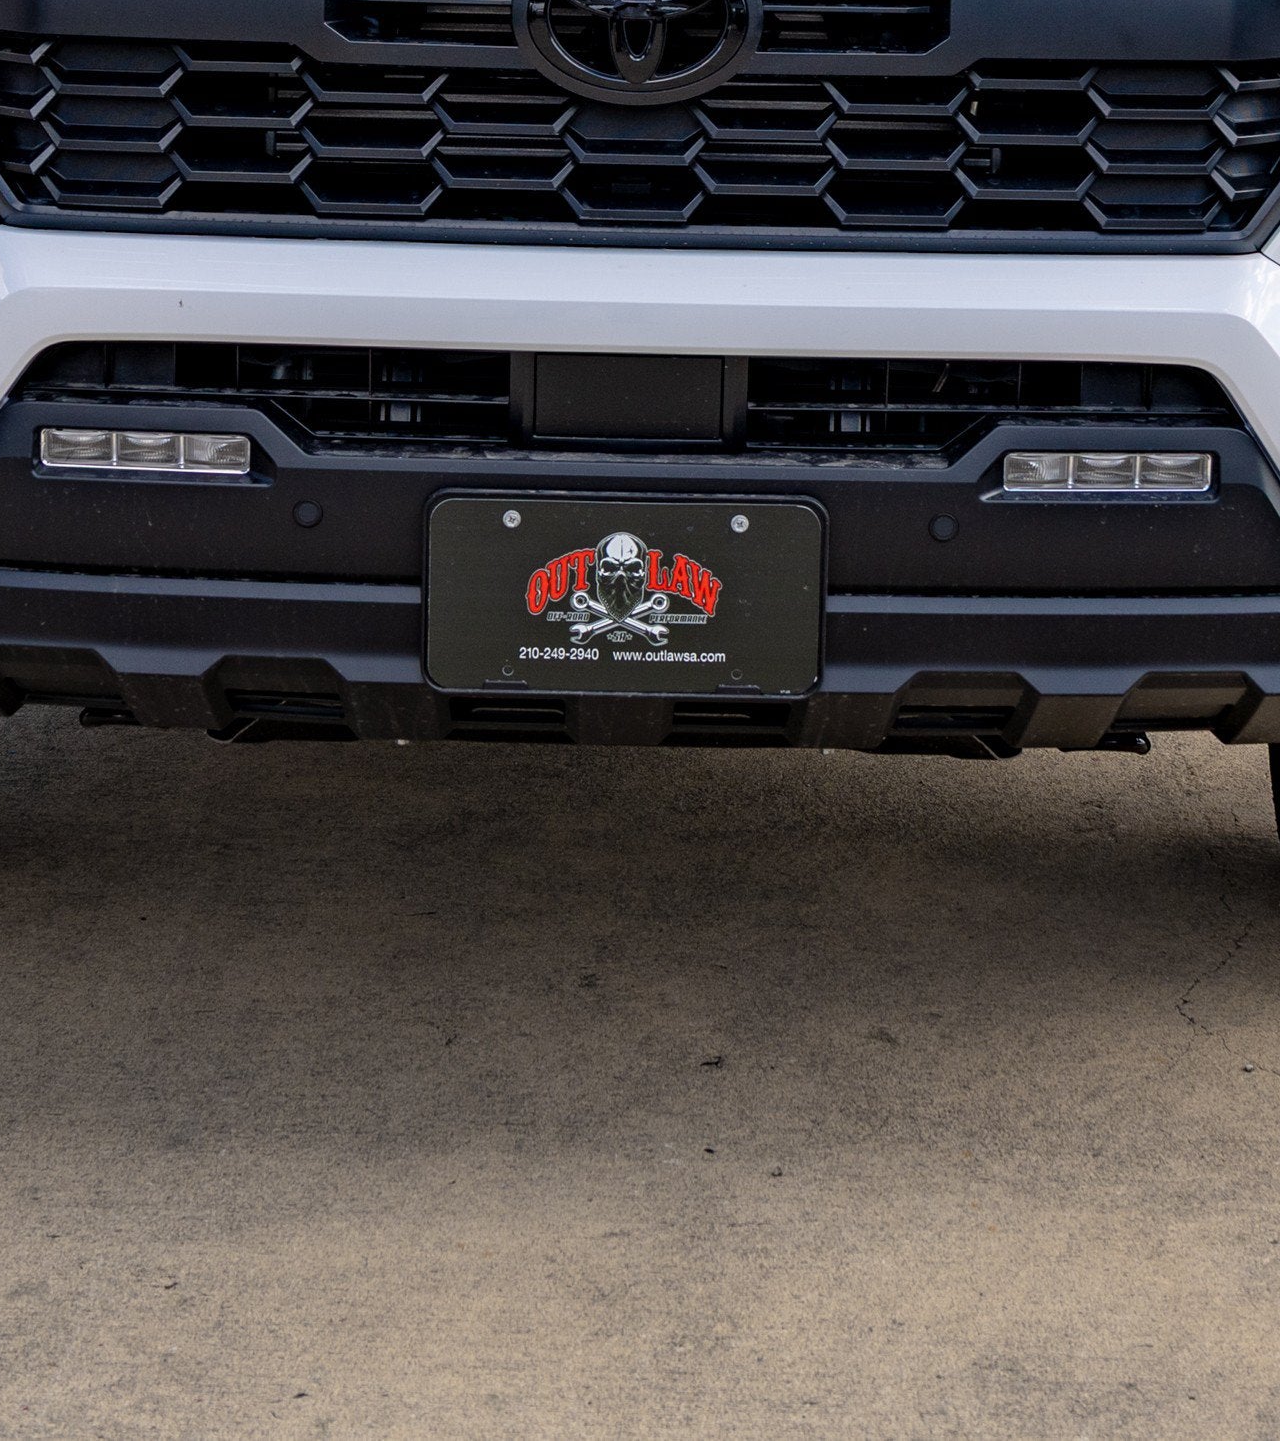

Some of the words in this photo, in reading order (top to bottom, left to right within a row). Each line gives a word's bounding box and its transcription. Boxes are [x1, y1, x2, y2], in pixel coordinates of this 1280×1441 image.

[546, 611, 591, 622] OFF-ROAD
[649, 614, 708, 624] PERFORMANCE
[519, 646, 600, 661] 210-249-2940
[612, 649, 726, 663] www.outlawsa.com
